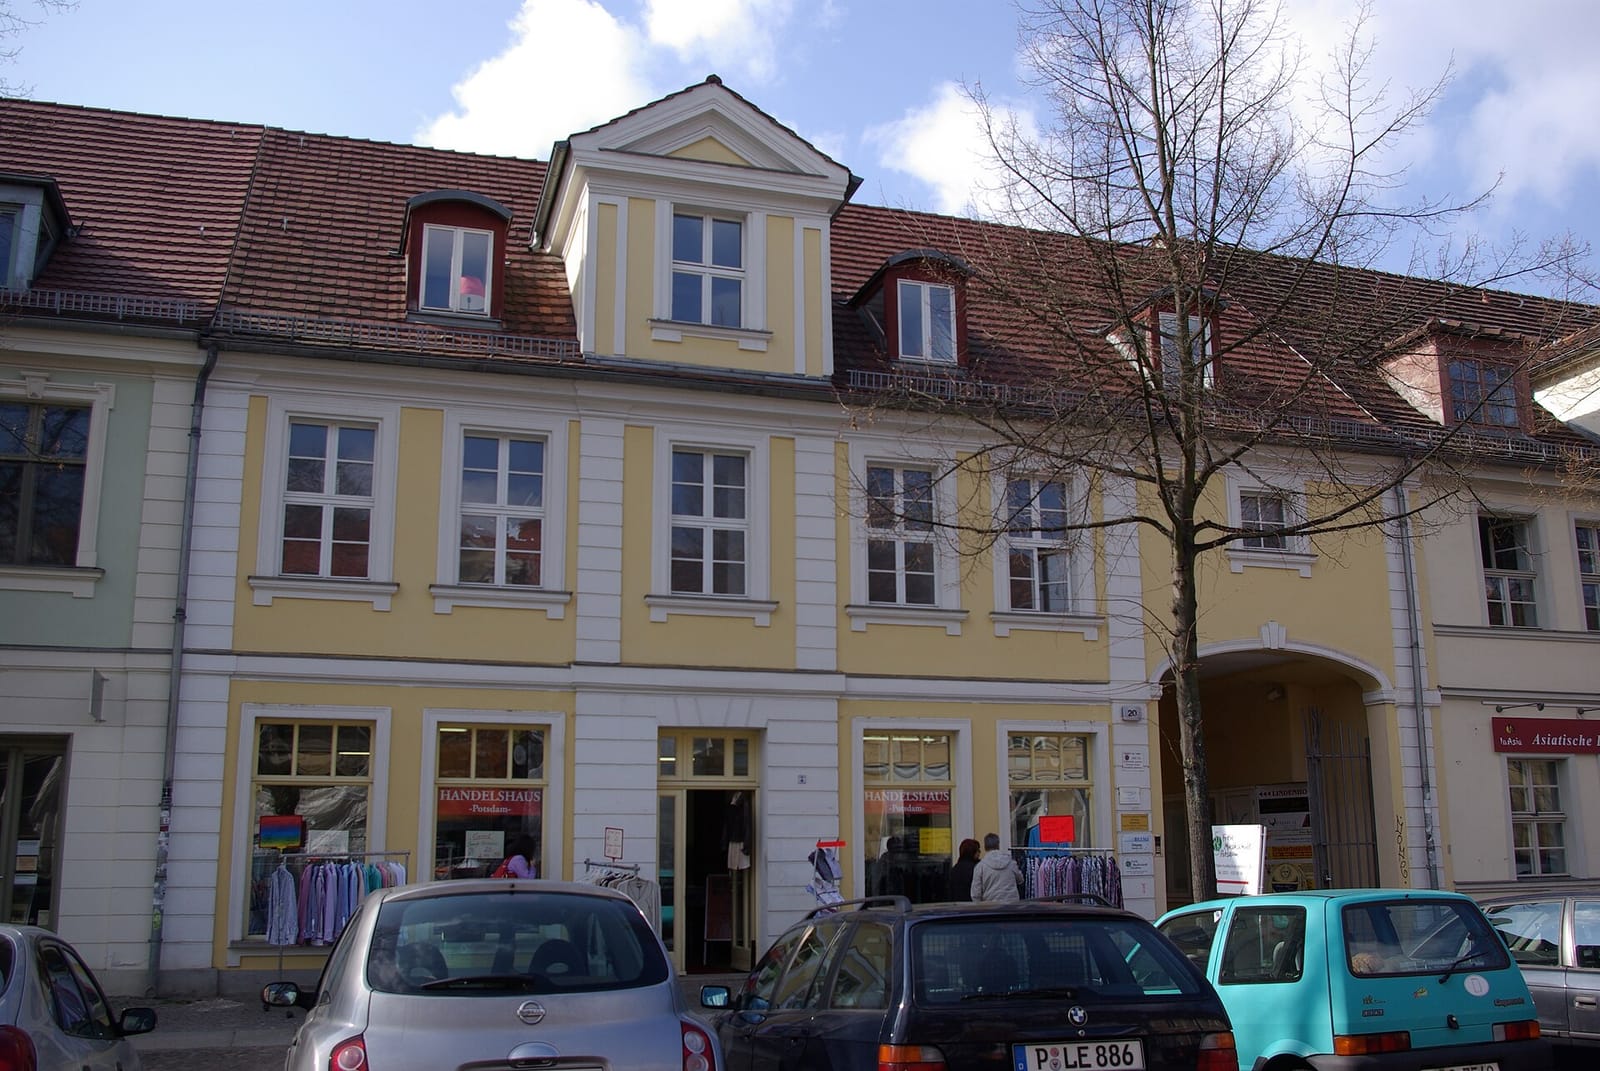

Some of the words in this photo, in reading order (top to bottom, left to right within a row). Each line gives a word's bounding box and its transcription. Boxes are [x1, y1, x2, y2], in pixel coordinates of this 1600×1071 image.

[1127, 709, 1137, 717] 20
[1532, 733, 1592, 747] Asiatische
[440, 790, 541, 802] HANDELSHAUS
[864, 791, 949, 801] HANDELSHAUS
[1035, 1048, 1049, 1070] P
[1063, 1046, 1092, 1069] LE
[1096, 1044, 1134, 1067] 886
